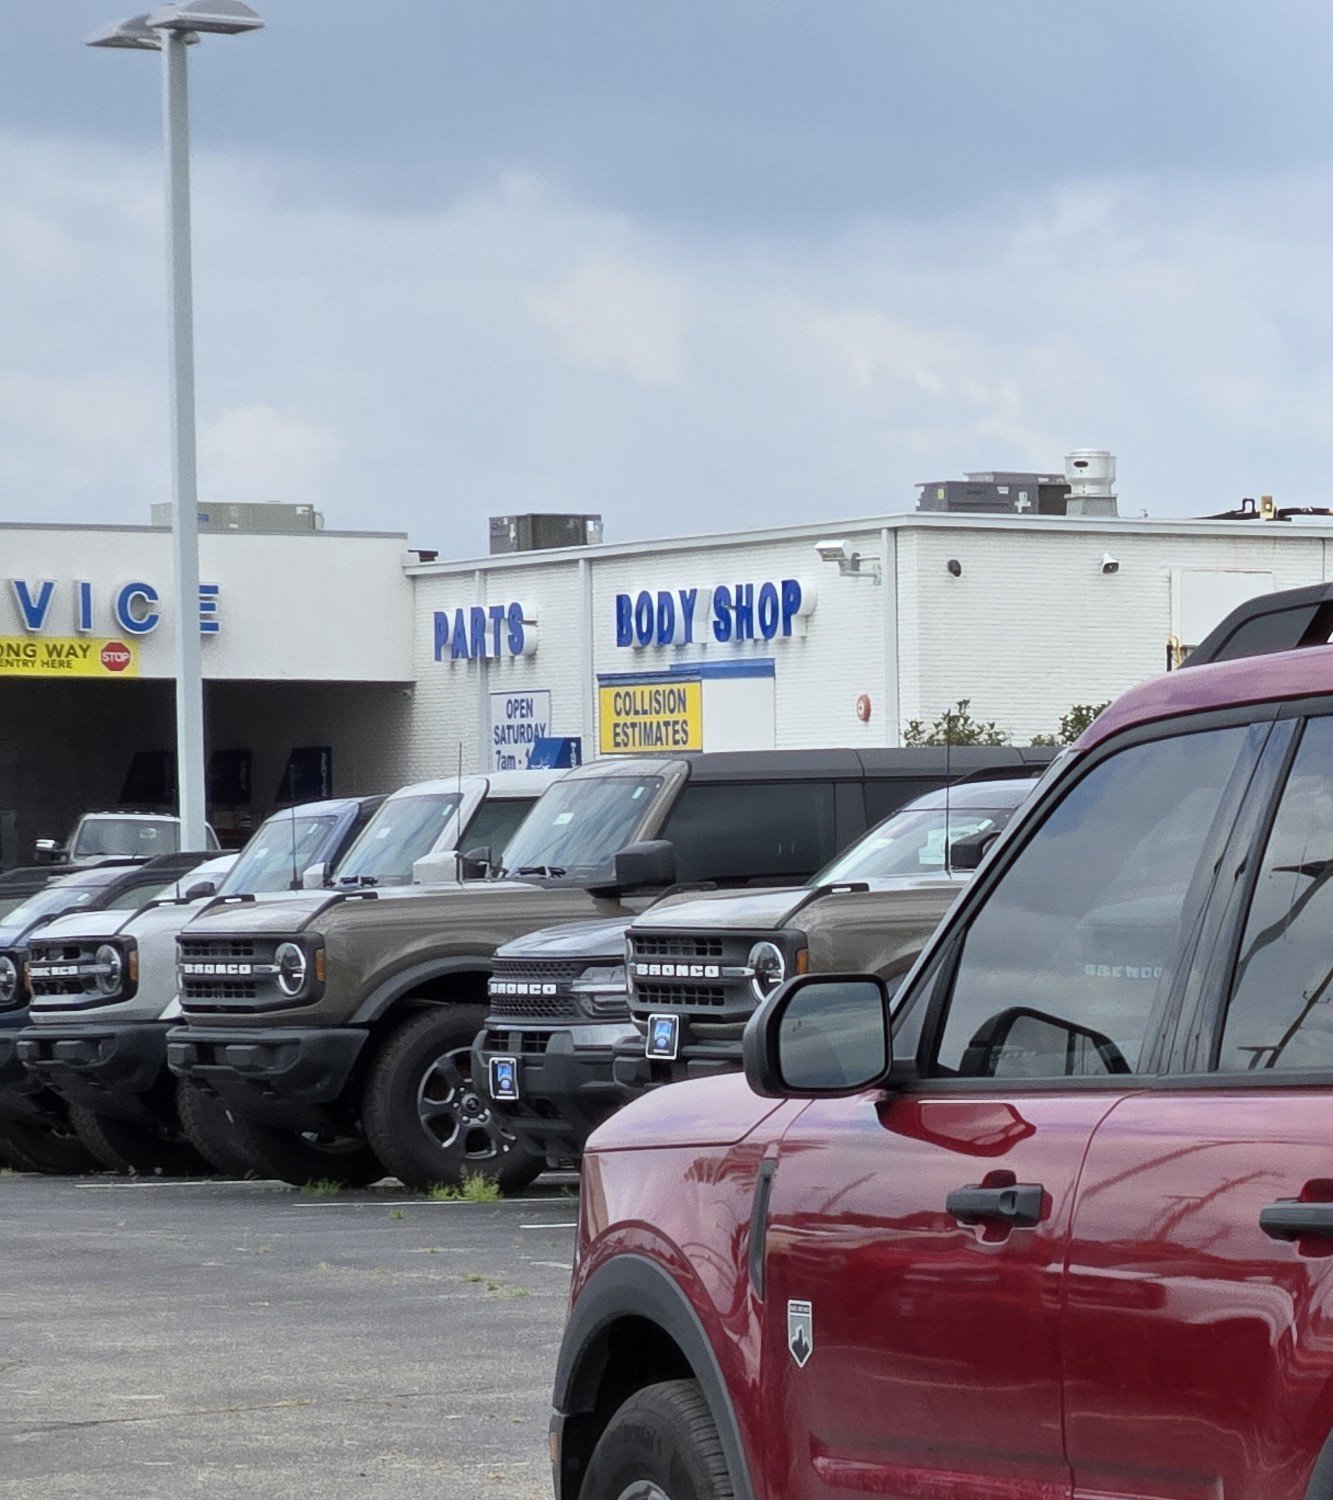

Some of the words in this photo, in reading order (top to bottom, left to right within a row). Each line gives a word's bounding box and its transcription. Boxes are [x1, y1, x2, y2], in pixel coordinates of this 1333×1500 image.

[616, 588, 699, 648] BODY
[712, 578, 803, 643] SHOP
[434, 602, 527, 661] PARTS
[45, 643, 91, 659] WAY
[102, 652, 130, 662] STOP
[41, 659, 73, 669] HERE
[506, 697, 533, 720] OPEN
[614, 688, 687, 716] COLLISION
[494, 722, 546, 745] SATURDAY
[613, 719, 689, 747] ESTIMATES
[636, 964, 719, 978] BRONCO
